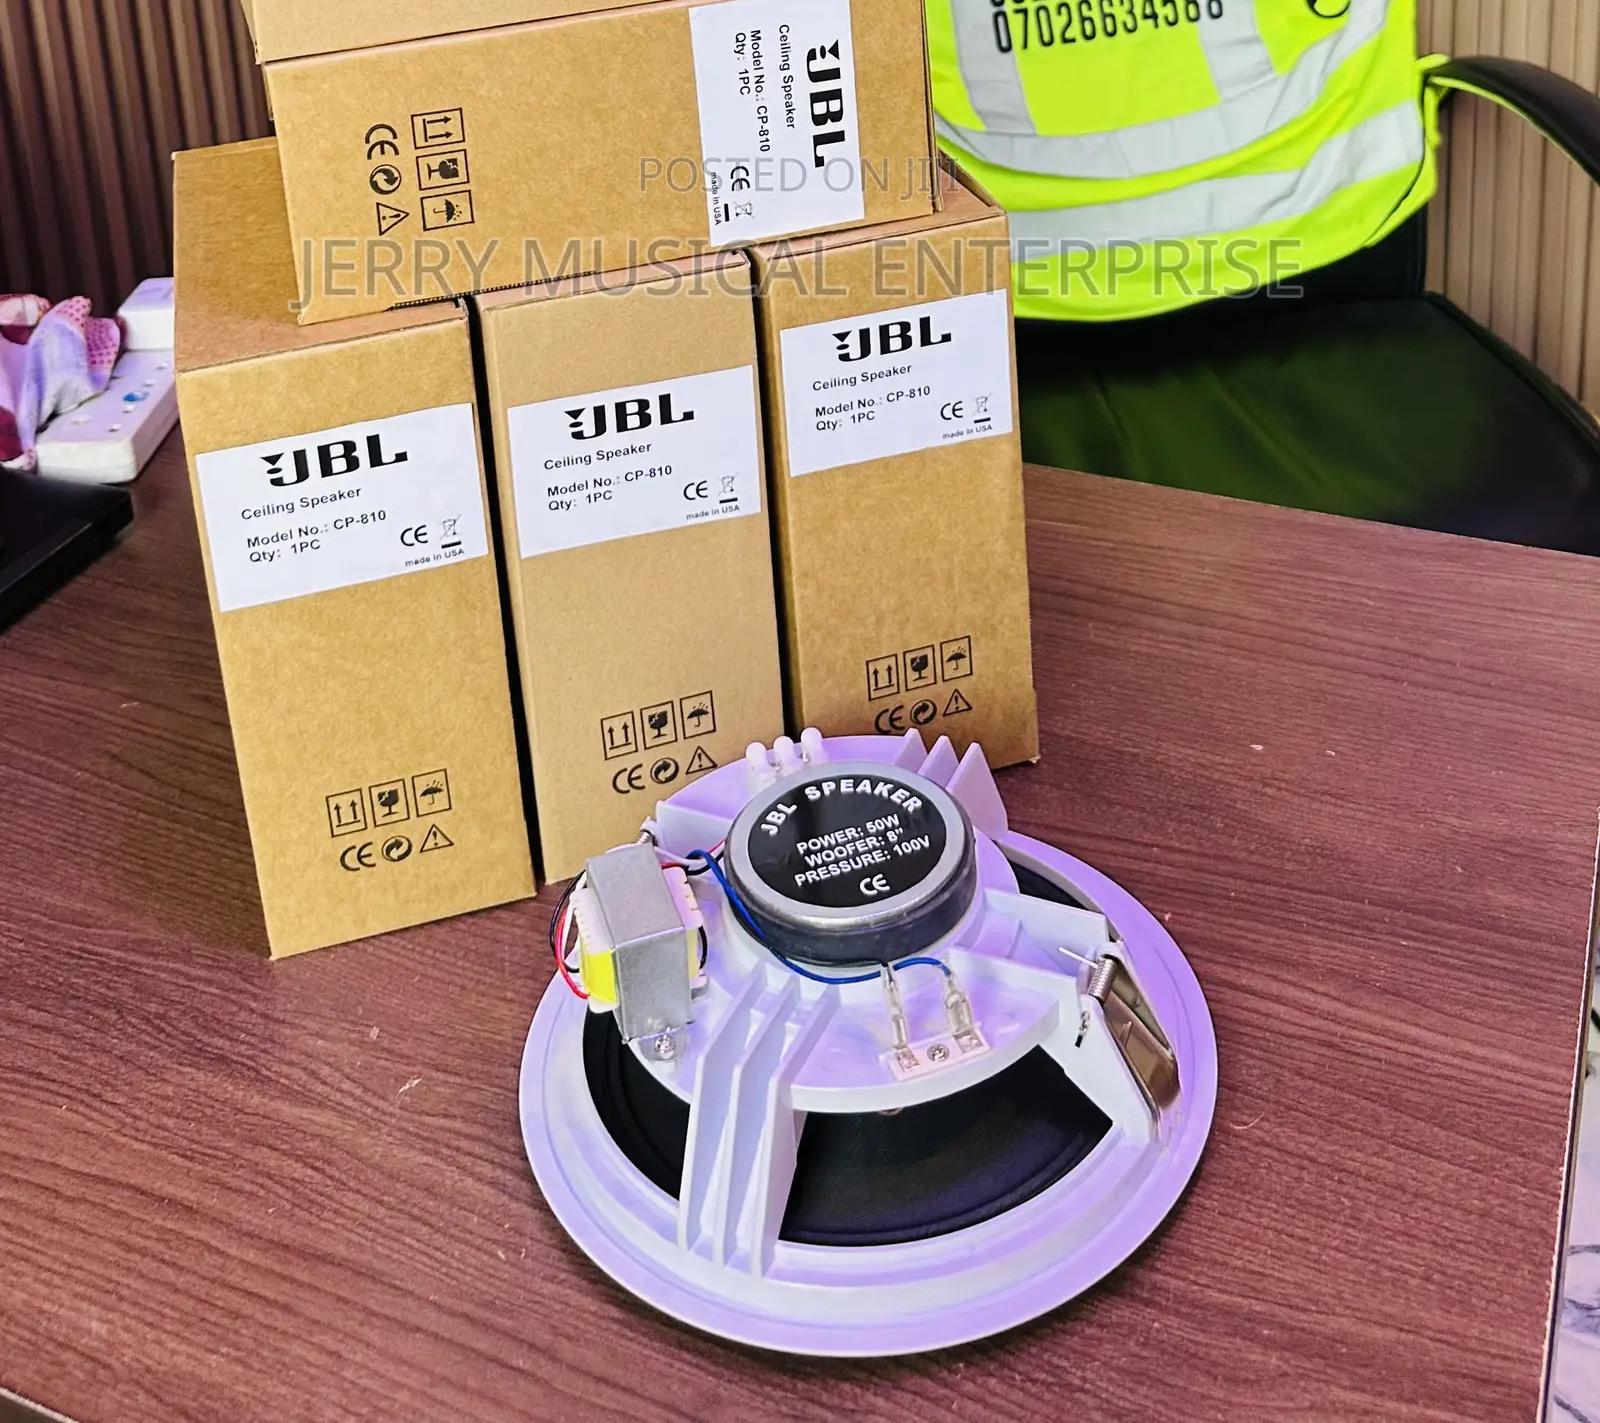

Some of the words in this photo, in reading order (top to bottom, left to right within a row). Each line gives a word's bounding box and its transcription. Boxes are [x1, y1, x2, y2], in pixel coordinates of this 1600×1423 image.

[733, 32, 747, 61] Qty:
[750, 29, 764, 71] Model
[778, 24, 791, 72] Ceiling
[738, 68, 751, 95] 1PC
[782, 75, 796, 129] Speaker
[806, 40, 846, 168] JBL
[756, 105, 771, 152] CP-810
[713, 206, 721, 226] USA
[832, 315, 952, 363] JBL
[812, 374, 857, 392] Ceiling
[861, 365, 912, 383] Speaker
[564, 393, 695, 441] JBL
[815, 401, 853, 417] Model
[886, 385, 931, 404] CP-810
[816, 417, 843, 432] Qty:
[850, 411, 876, 425] 1PC
[942, 430, 964, 439] made
[975, 424, 993, 433] USA
[260, 433, 409, 487] JBL
[544, 452, 592, 471] Ceiling
[596, 442, 652, 462] Speaker
[547, 480, 589, 497] Model
[624, 464, 673, 483] CP-810
[241, 499, 296, 521] Ceiling
[300, 487, 362, 509] Speaker
[548, 497, 578, 511] Qty:
[585, 490, 613, 504] 1PC
[686, 510, 710, 521] made
[711, 507, 720, 515] in
[721, 504, 740, 513] USA
[247, 530, 294, 548] Model
[333, 509, 387, 531] CP-810
[249, 548, 282, 564] Qty:
[290, 539, 321, 555] 1PC
[405, 557, 431, 568] made
[433, 553, 442, 561] in
[444, 548, 465, 558] USA
[761, 801, 798, 837] JBL
[804, 778, 923, 814] SPEAKER
[796, 826, 864, 855] POWER:
[865, 813, 900, 834] 50W
[794, 848, 891, 887] PRESSURE:
[892, 834, 931, 858] 100V
[804, 836, 885, 868] WOOFER:
